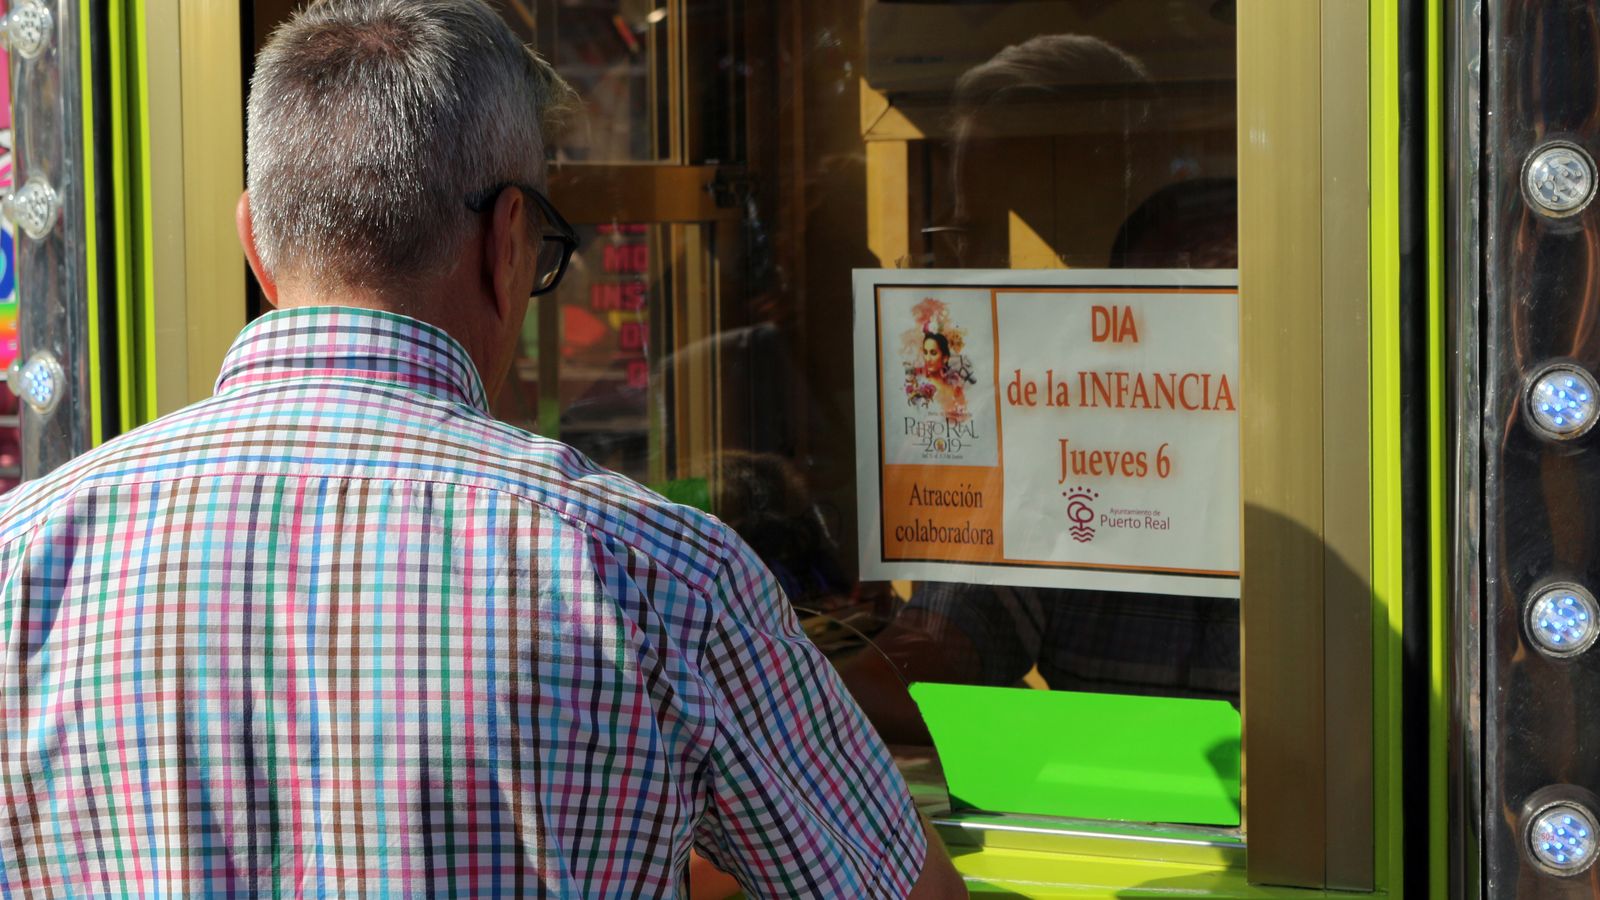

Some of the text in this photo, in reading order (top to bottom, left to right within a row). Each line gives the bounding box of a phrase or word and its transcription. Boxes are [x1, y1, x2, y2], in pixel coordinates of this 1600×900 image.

[1091, 305, 1139, 343] DIA
[1007, 369, 1236, 411] de la INFANCIA
[924, 438, 962, 453] 2019
[1058, 438, 1171, 484] Jueves 6
[909, 482, 983, 508] Atracción
[1100, 514, 1170, 530] Puerto Real
[1110, 508, 1151, 516] Ayuntamiento
[896, 518, 994, 545] colaboradora
